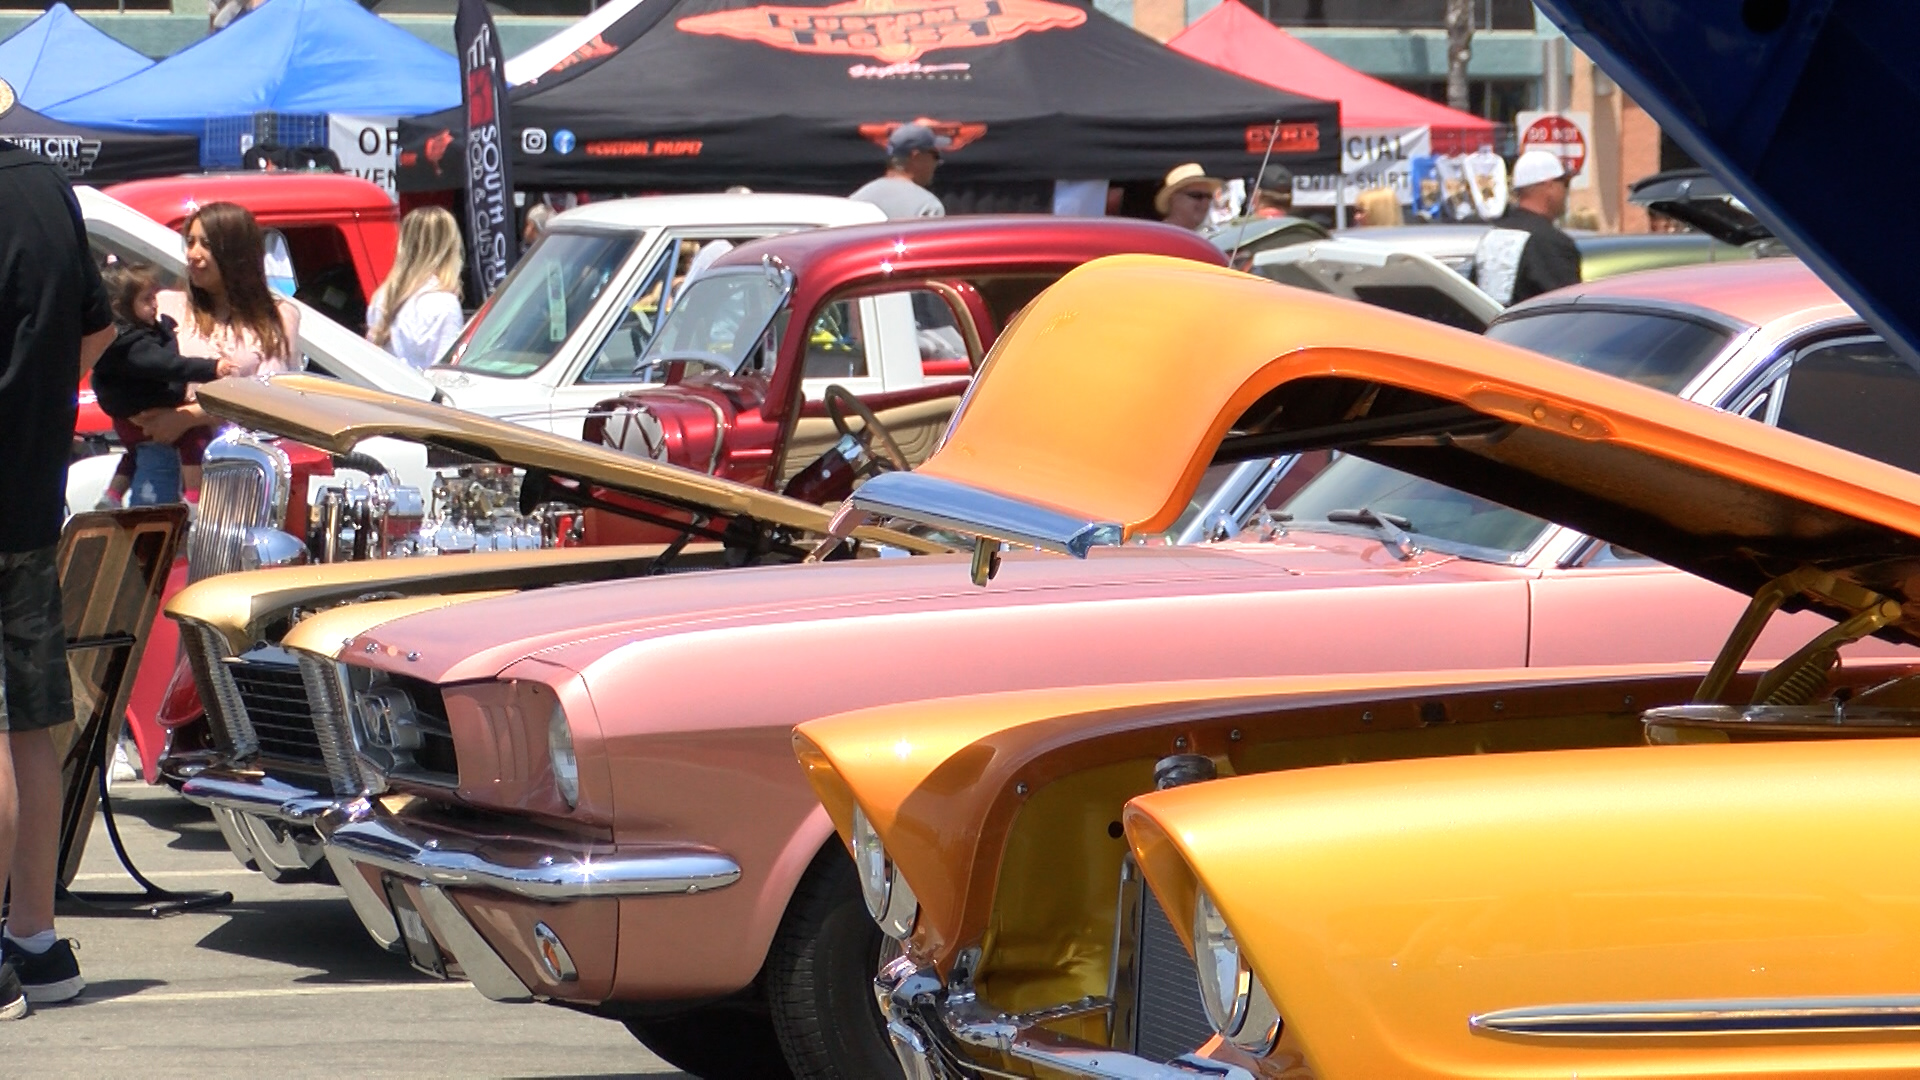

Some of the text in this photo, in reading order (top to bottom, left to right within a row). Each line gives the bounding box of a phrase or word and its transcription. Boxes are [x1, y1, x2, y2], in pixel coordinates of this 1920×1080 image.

[45, 138, 79, 158] CITY
[470, 129, 484, 180] ROD
[1346, 135, 1408, 160] CIAL
[474, 188, 486, 204] &
[482, 125, 507, 282] SOUTH CIT
